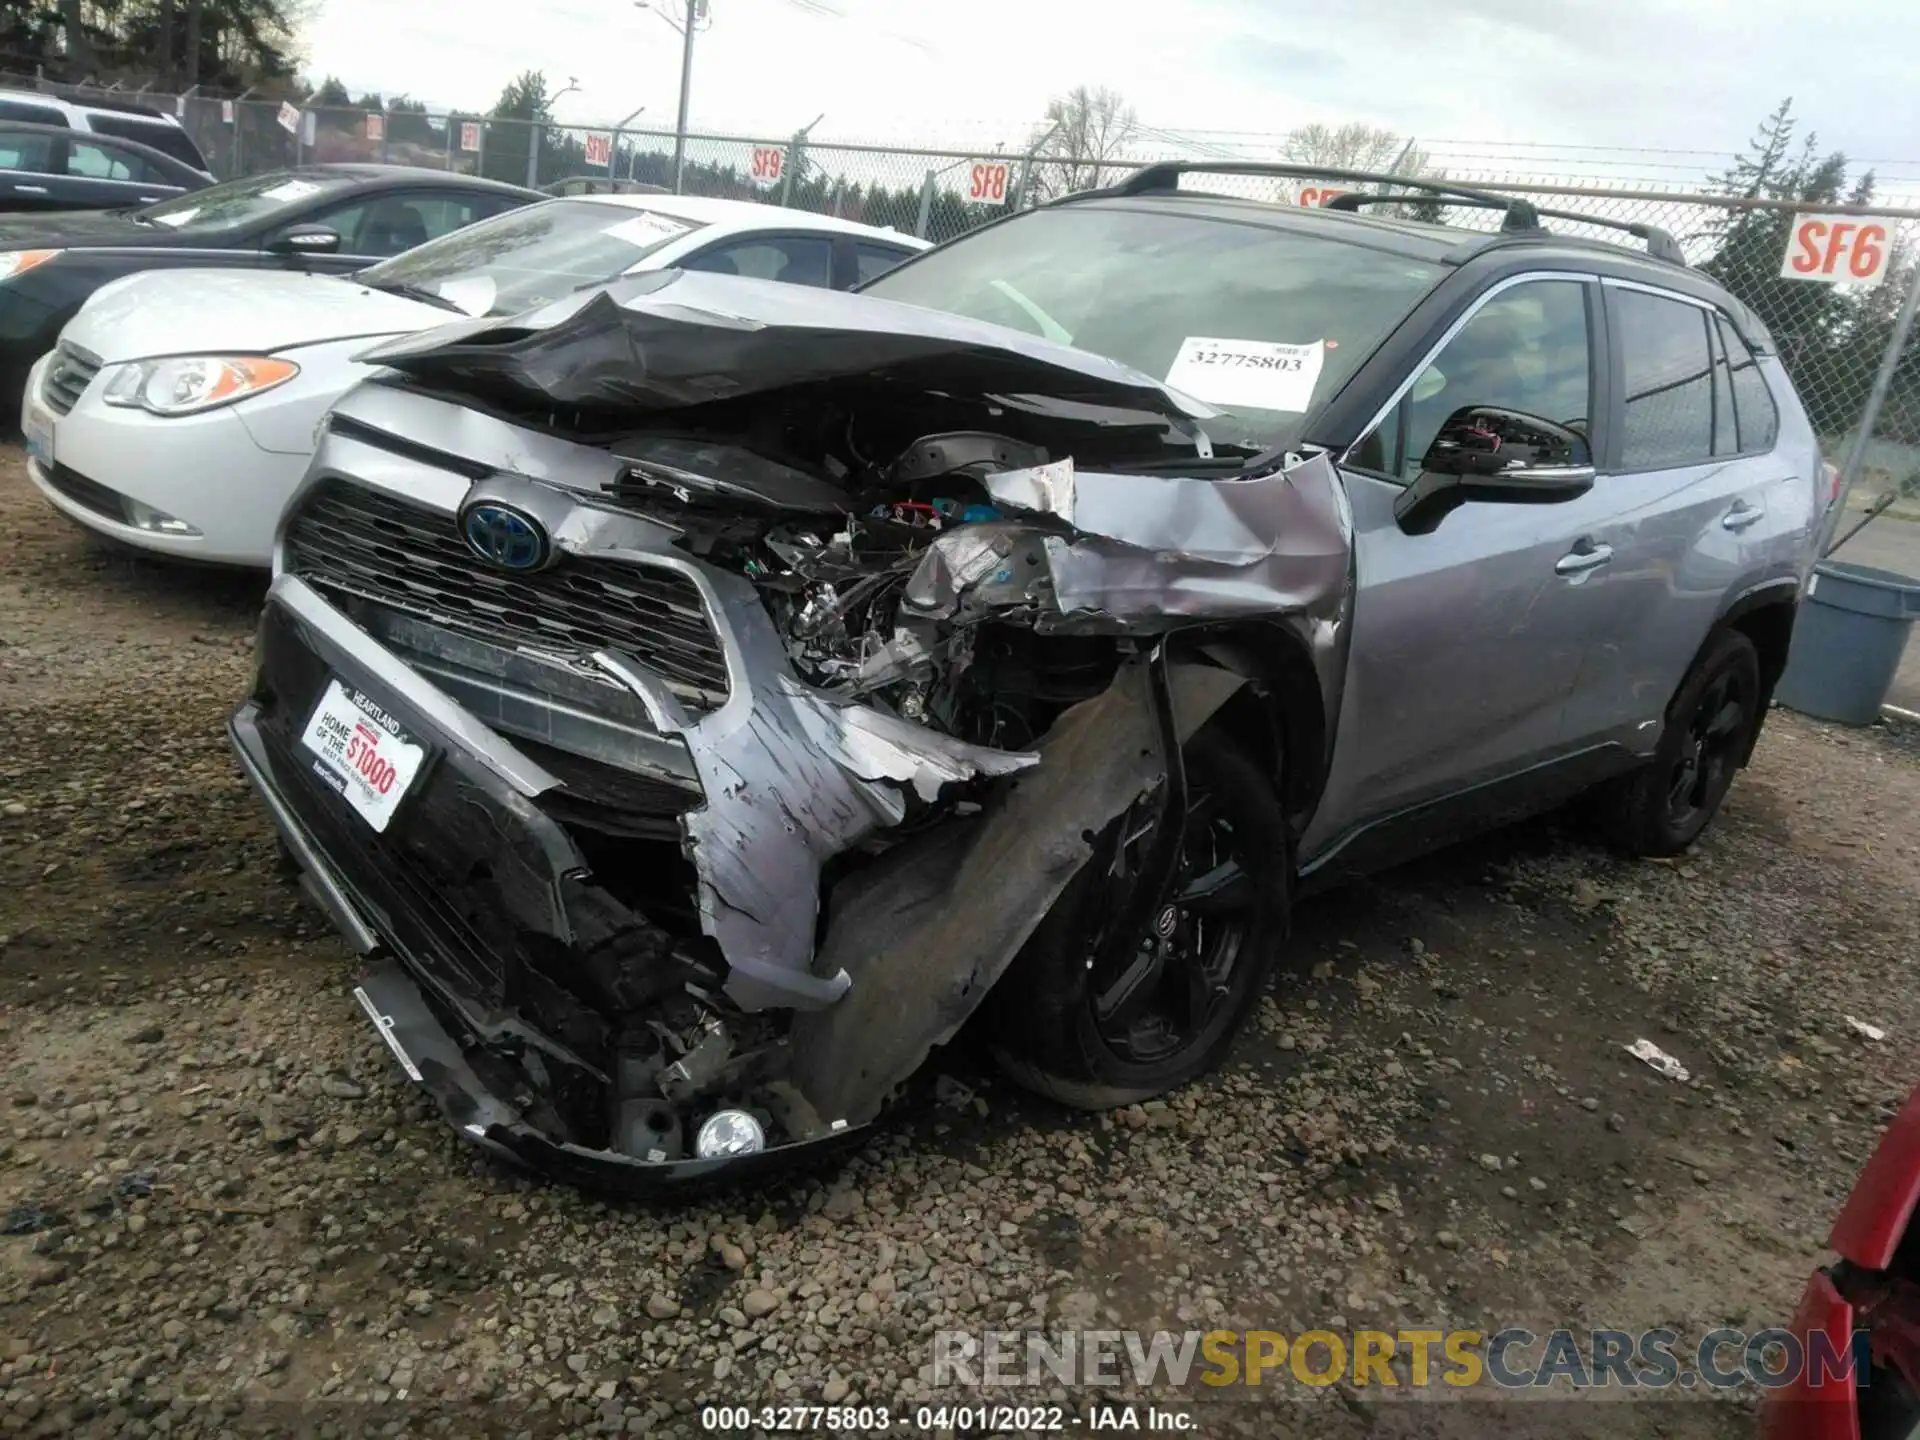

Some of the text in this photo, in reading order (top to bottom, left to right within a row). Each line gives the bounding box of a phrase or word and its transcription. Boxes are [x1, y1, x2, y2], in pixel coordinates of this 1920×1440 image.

[753, 149, 780, 177] SF9
[971, 164, 1006, 199] SF8
[1792, 220, 1886, 278] SF6
[1189, 350, 1303, 372] 32775803
[321, 711, 351, 741] HOME
[352, 689, 400, 735] HEARTLAND
[315, 725, 328, 739] OF
[328, 734, 345, 754] THE
